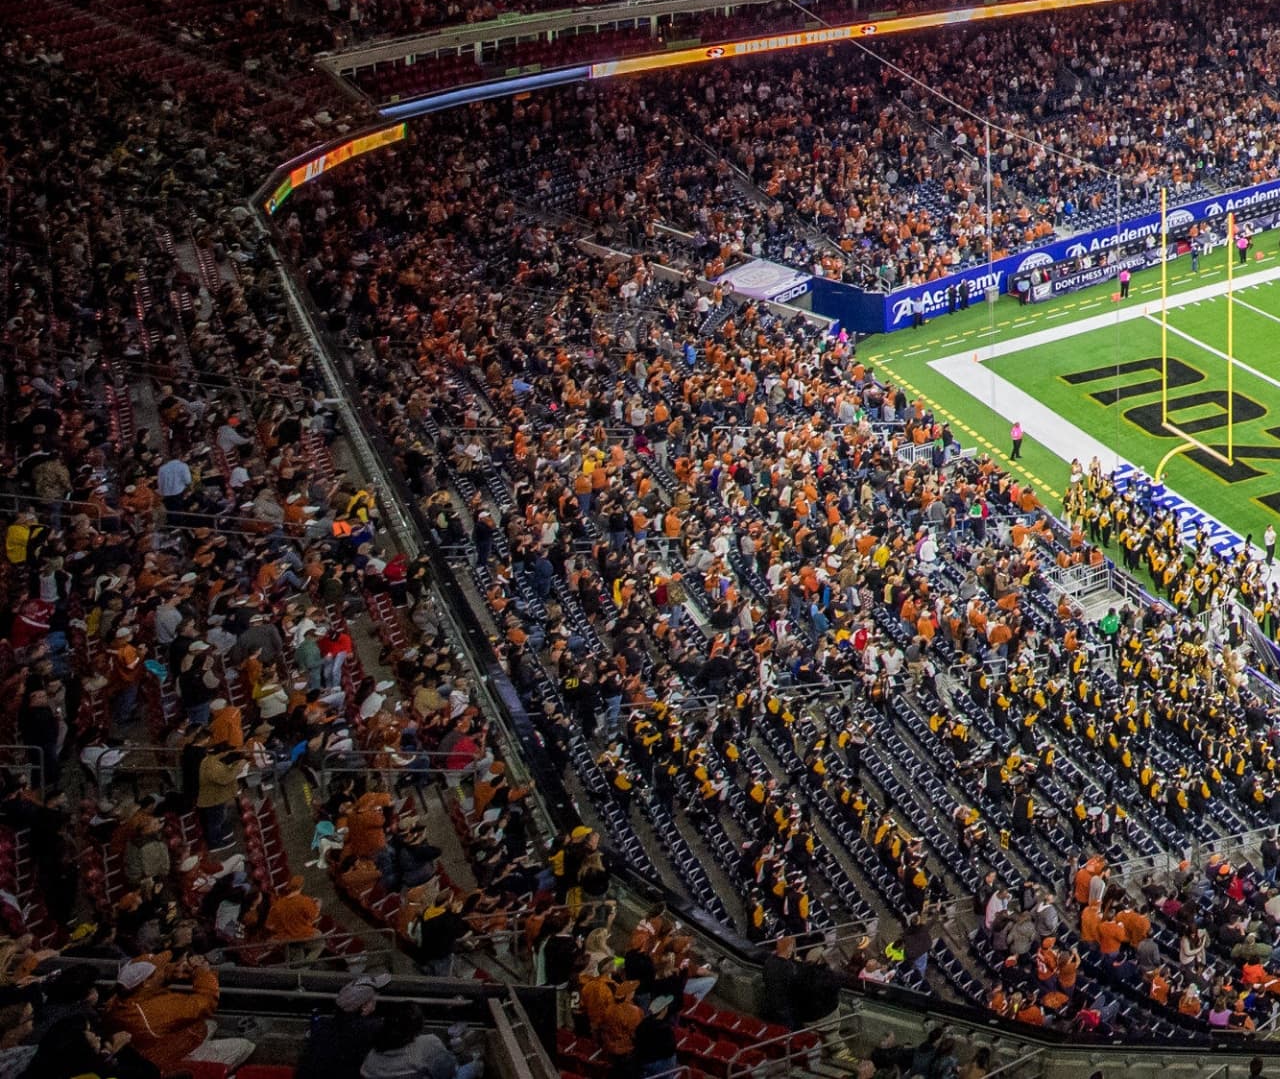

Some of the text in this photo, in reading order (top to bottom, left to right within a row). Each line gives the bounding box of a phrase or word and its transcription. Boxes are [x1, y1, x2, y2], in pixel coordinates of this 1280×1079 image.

[734, 28, 851, 54] MISSOURI TIGERS
[1090, 224, 1159, 252] Academy
[1055, 276, 1081, 291] DON'T
[1082, 269, 1102, 283] MESS
[1103, 264, 1122, 277] WITH
[774, 283, 808, 303] GEICO
